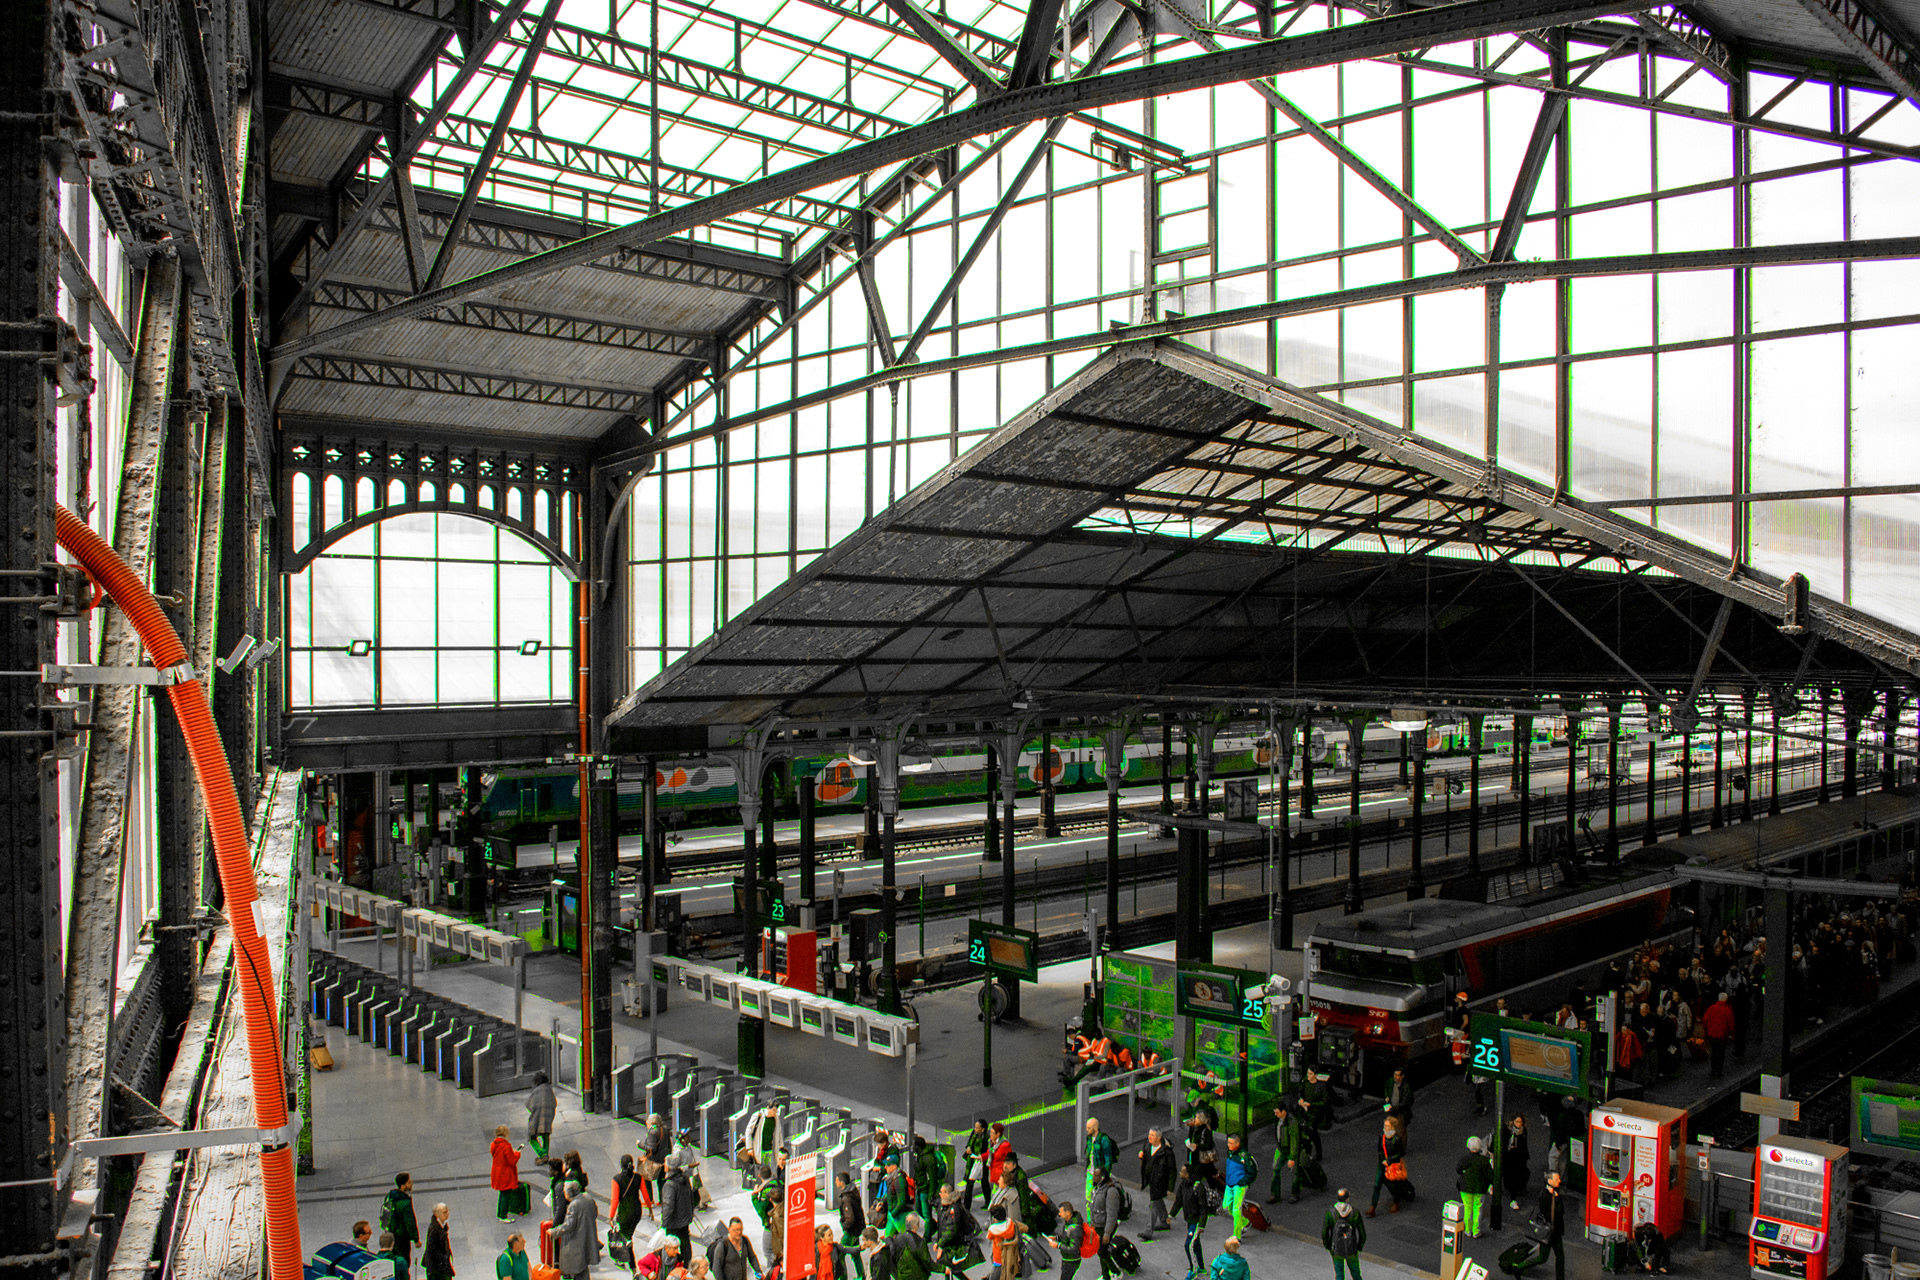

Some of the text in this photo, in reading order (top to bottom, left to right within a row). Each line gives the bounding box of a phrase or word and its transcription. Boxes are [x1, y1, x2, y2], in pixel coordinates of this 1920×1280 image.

[484, 846, 493, 858] 21
[772, 903, 784, 918] 23
[969, 944, 986, 961] 24
[1242, 998, 1264, 1018] 25
[1368, 1009, 1387, 1018] SNCF
[1473, 1044, 1500, 1067] 26
[1616, 1121, 1642, 1131] selecta
[1784, 1156, 1814, 1167] selecta
